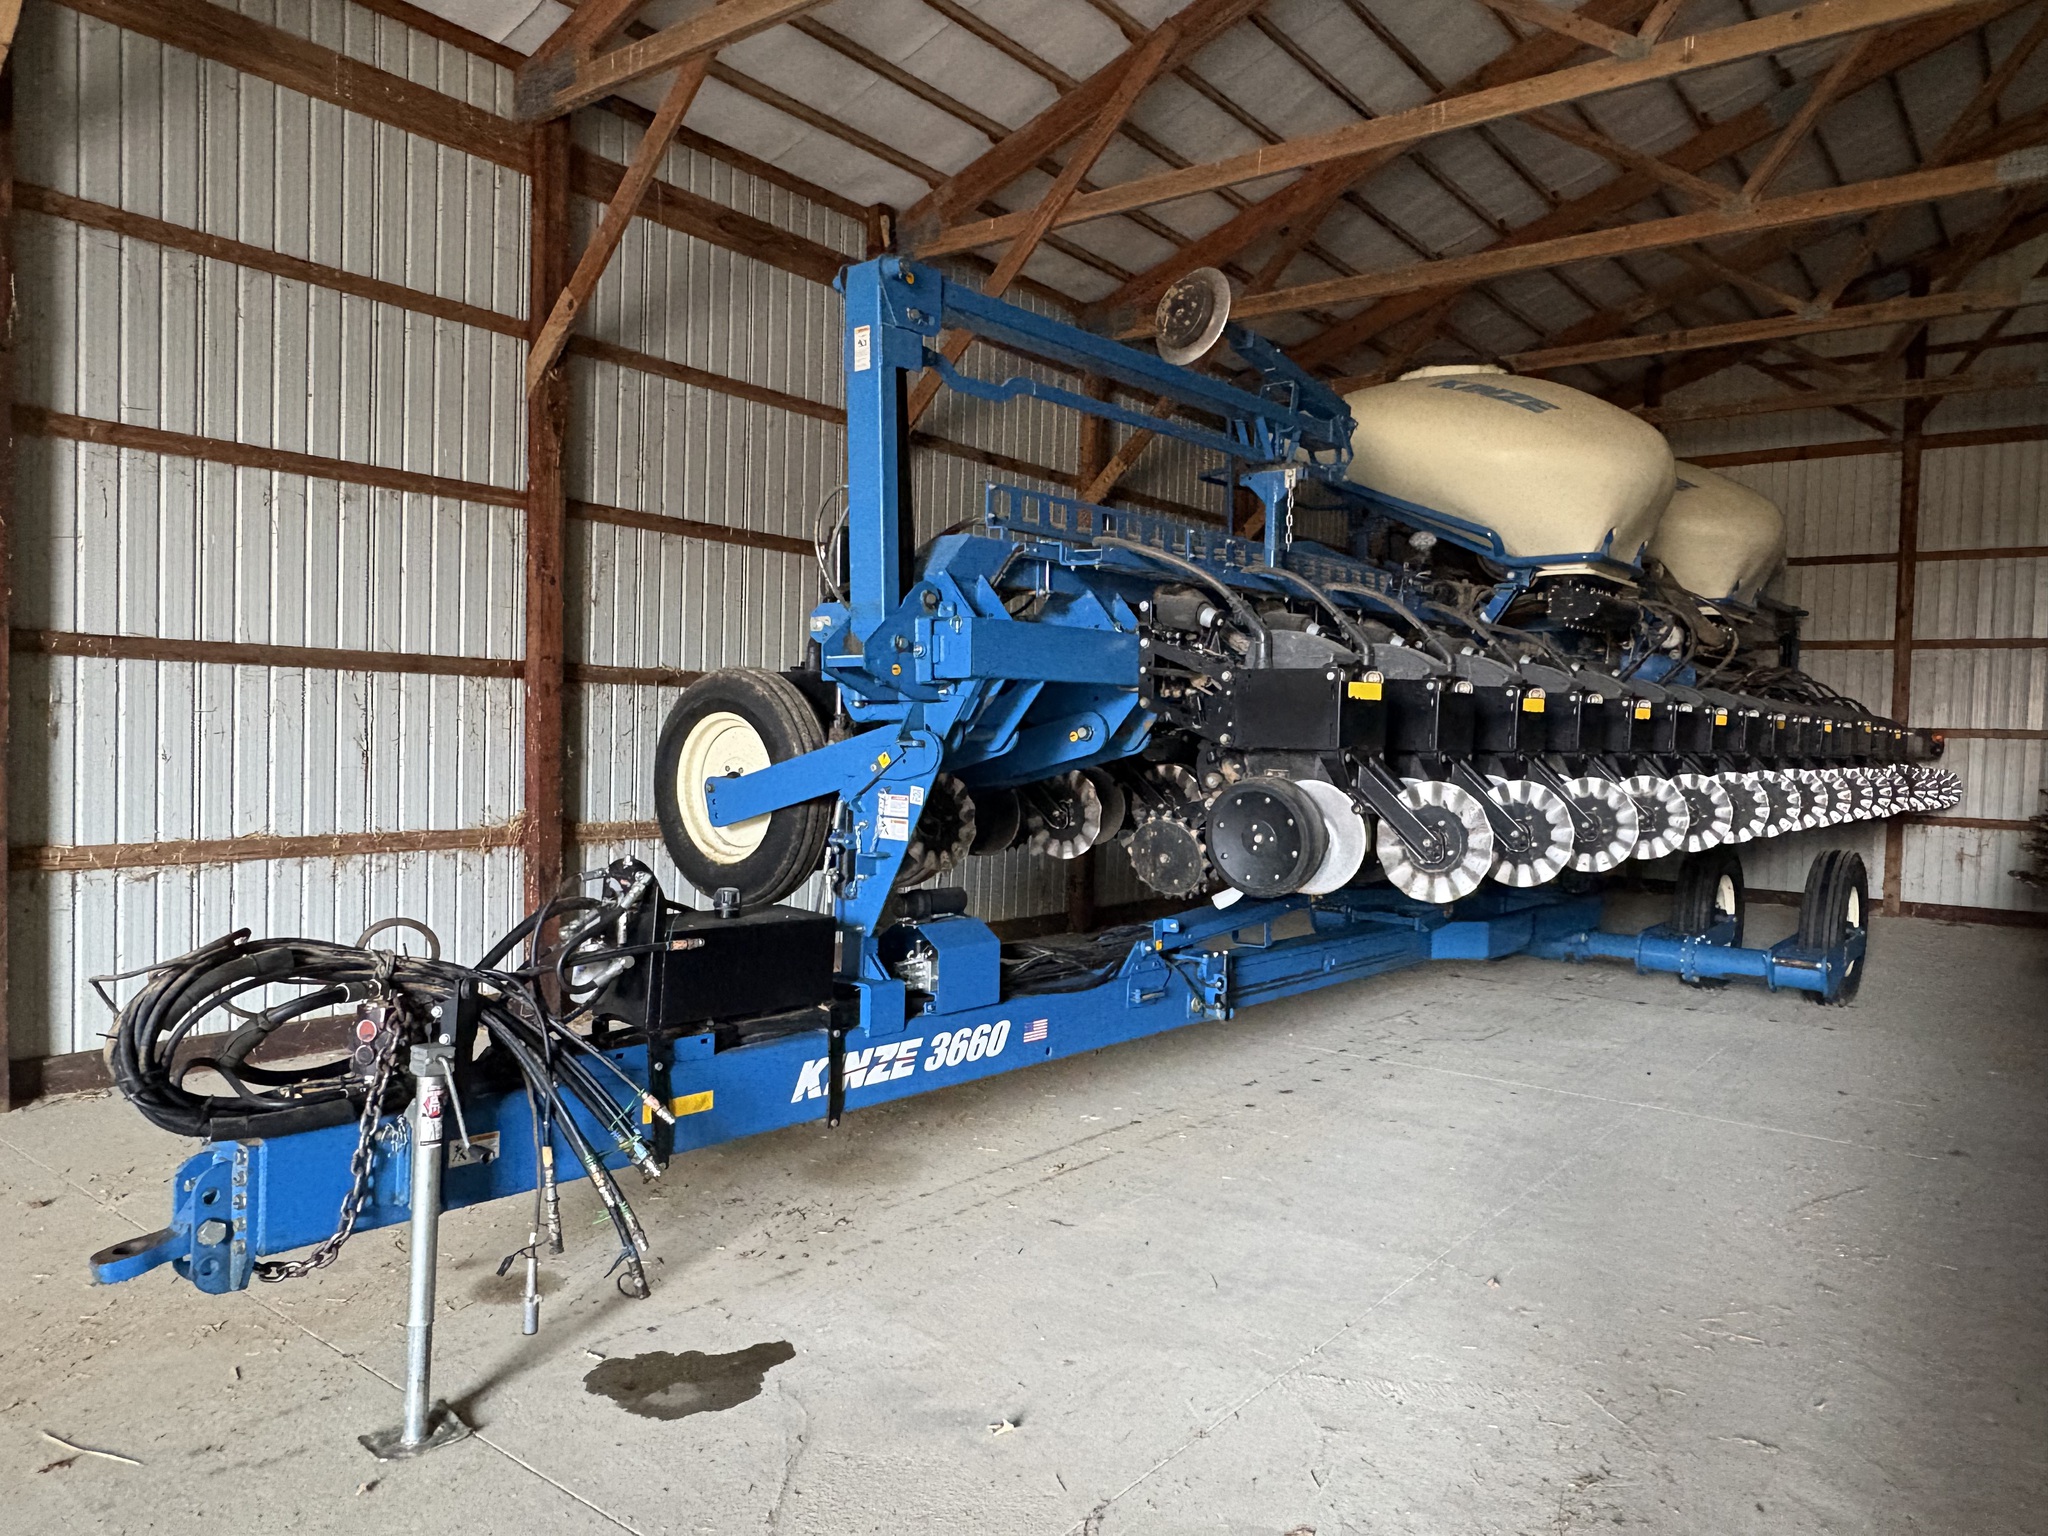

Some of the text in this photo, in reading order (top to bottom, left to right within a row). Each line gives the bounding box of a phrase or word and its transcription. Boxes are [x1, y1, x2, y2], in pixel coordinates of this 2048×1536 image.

[1427, 380, 1561, 413] KINZE
[791, 1020, 1011, 1103] KNZE 3660
